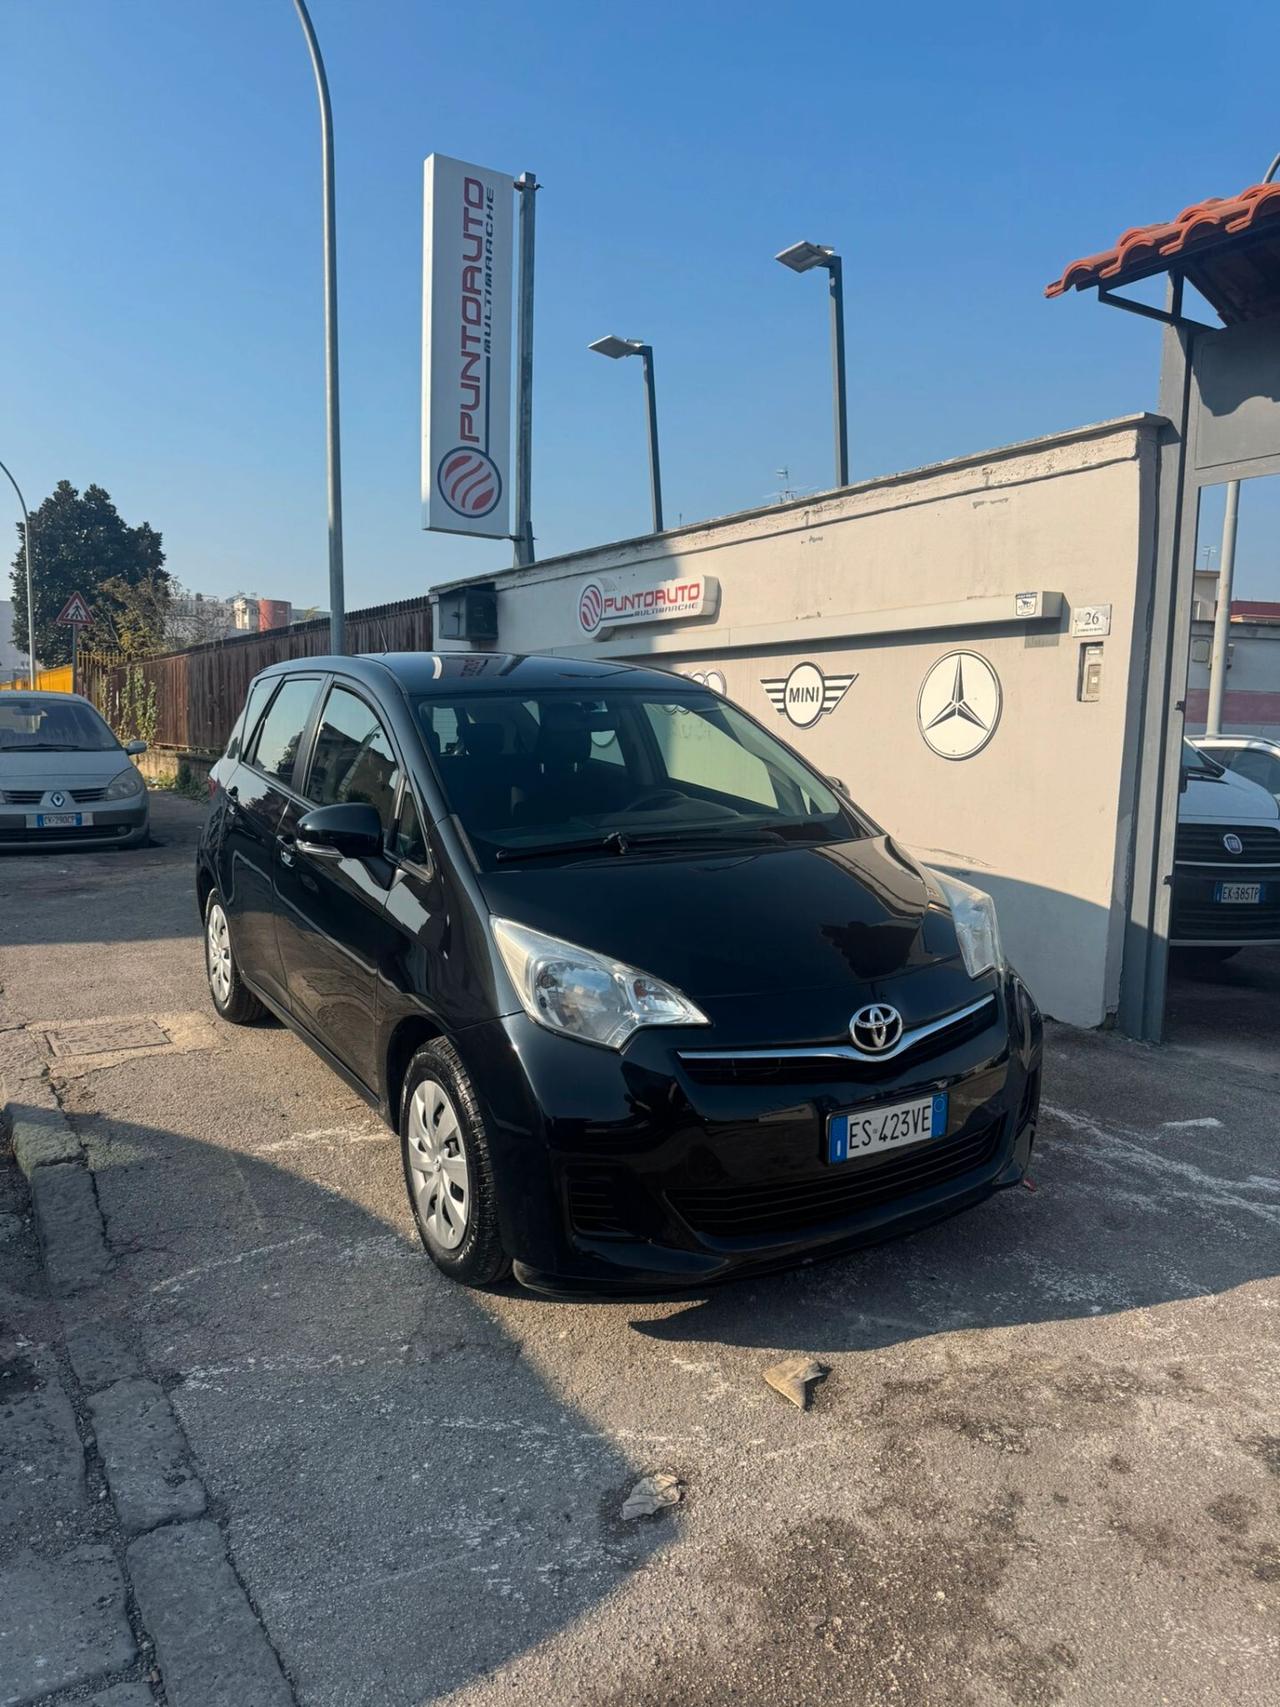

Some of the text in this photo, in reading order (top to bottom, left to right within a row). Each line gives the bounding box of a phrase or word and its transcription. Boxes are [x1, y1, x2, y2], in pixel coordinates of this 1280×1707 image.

[483, 185, 495, 354] MULTIMARCHE
[460, 176, 484, 443] PUNTOAUTO
[603, 583, 700, 614] PUNTOAUTO
[1085, 611, 1099, 625] 26
[789, 687, 820, 703] MINI
